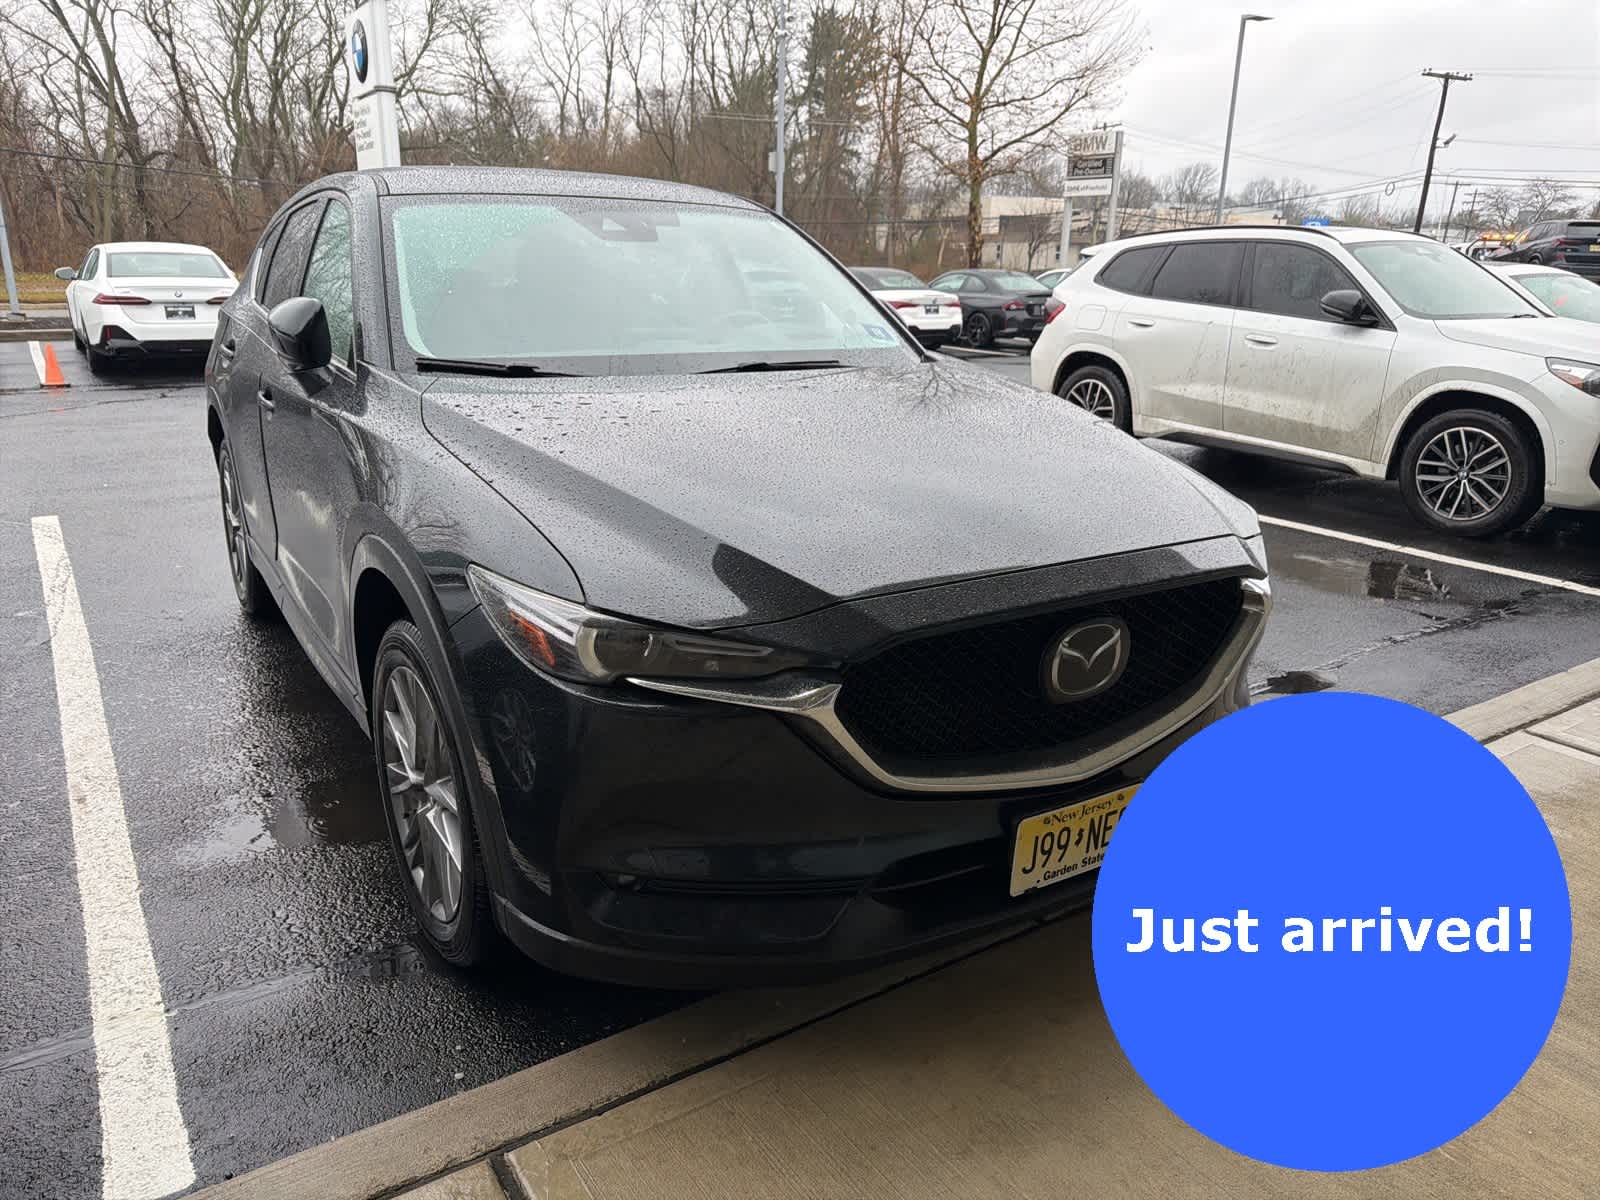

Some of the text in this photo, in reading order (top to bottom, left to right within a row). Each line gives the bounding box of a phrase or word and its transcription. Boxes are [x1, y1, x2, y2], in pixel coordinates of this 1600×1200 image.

[1051, 798, 1114, 826] New Jersey
[1022, 807, 1127, 874] J99 NE
[1043, 863, 1078, 881] Garden
